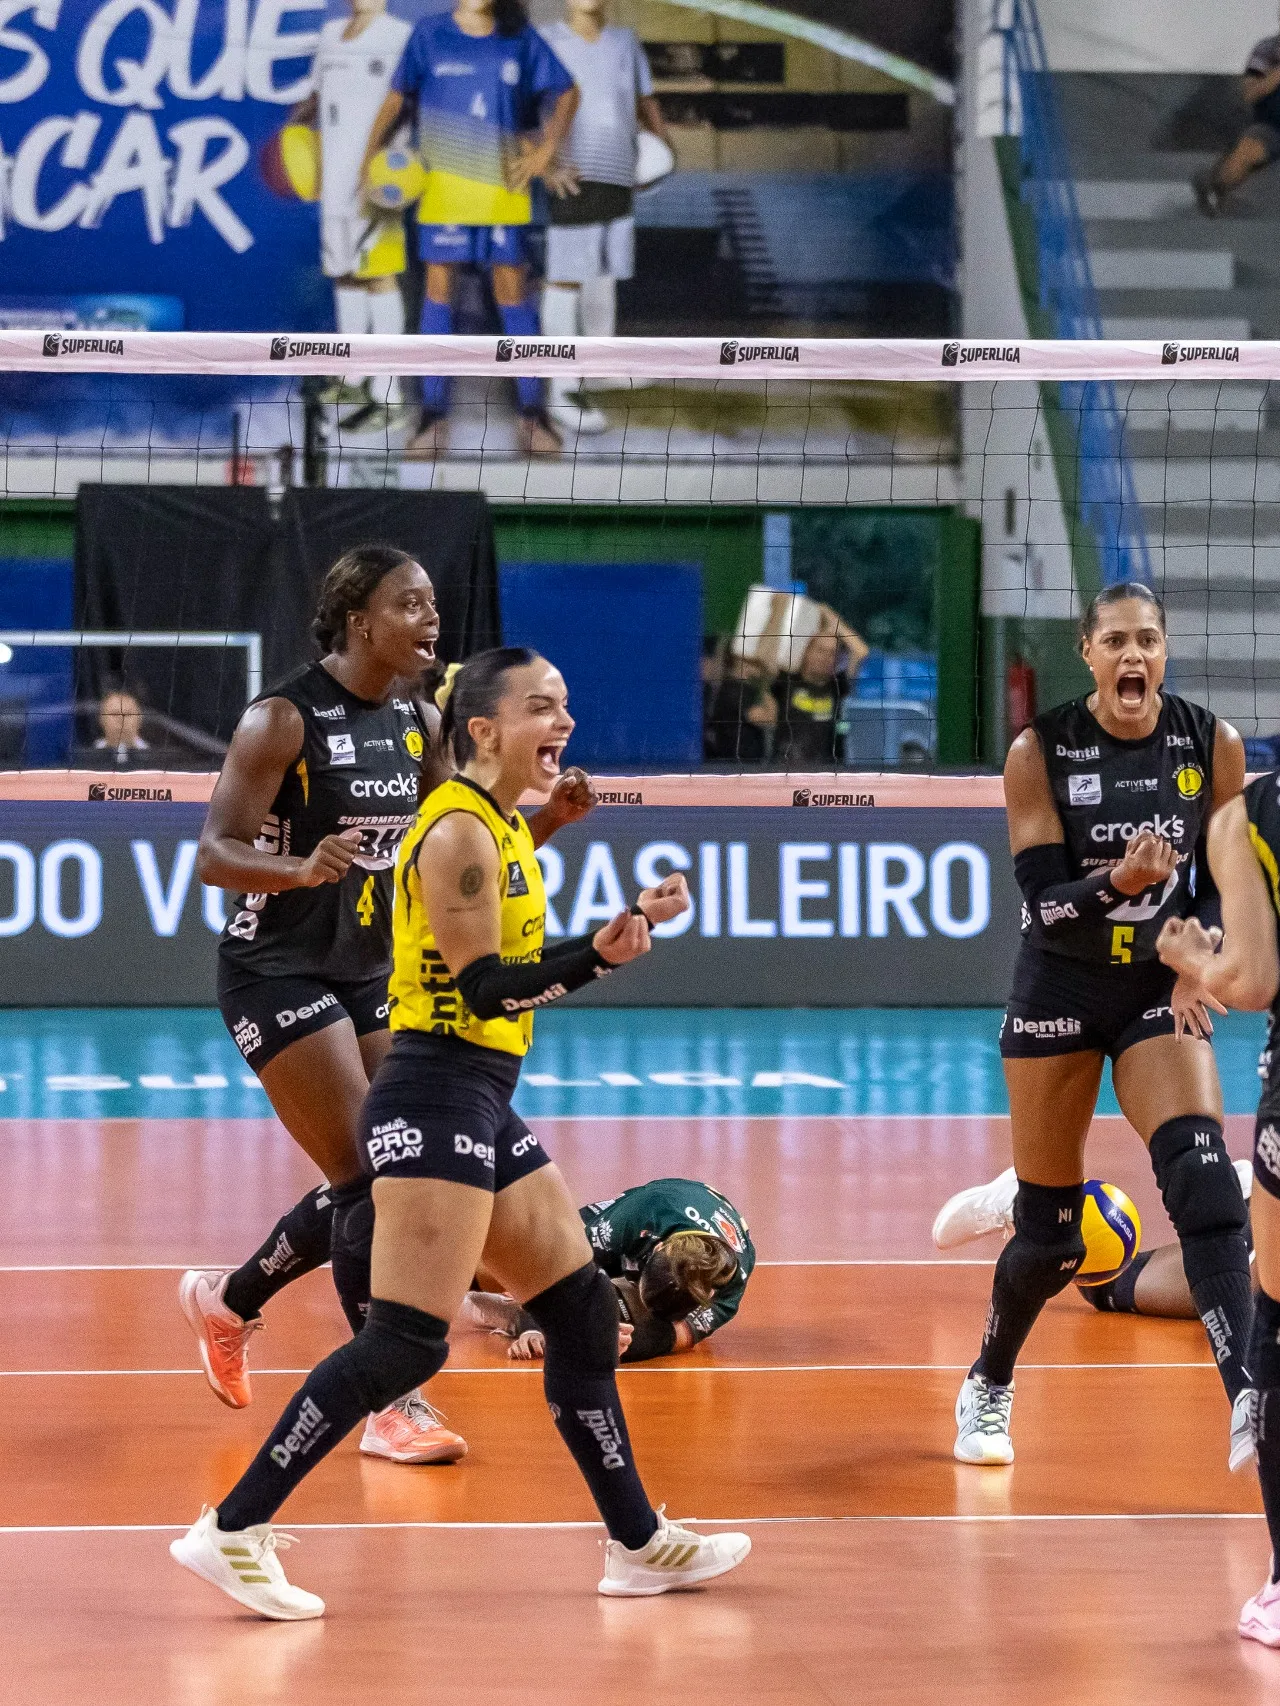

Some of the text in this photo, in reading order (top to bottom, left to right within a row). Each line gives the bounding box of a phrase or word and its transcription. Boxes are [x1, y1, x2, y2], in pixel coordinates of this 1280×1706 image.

[76, 0, 320, 109] QUE
[0, 110, 254, 254] CAR
[61, 338, 124, 357] SUPERLIGA
[288, 341, 351, 359] SUPERLIGA
[514, 342, 575, 361] SUPERLIGA
[738, 344, 800, 363] SUPERLIGA
[959, 344, 1020, 364] SUPERLIGA
[1179, 345, 1240, 364] SUPERLIGA
[107, 788, 173, 802] SUPERLIGA
[597, 792, 643, 805] PERLIGA
[812, 794, 875, 808] SUPERLIGA
[357, 875, 374, 926] 4
[535, 840, 992, 939] RASILEIRO
[1111, 926, 1135, 964] 5
[275, 993, 339, 1028] Dentil
[235, 1022, 260, 1050] PRO
[367, 1127, 423, 1160] PRO
[372, 1145, 424, 1172] PLAY
[271, 1396, 325, 1470] Dentil
[576, 1409, 626, 1470] Dentil
